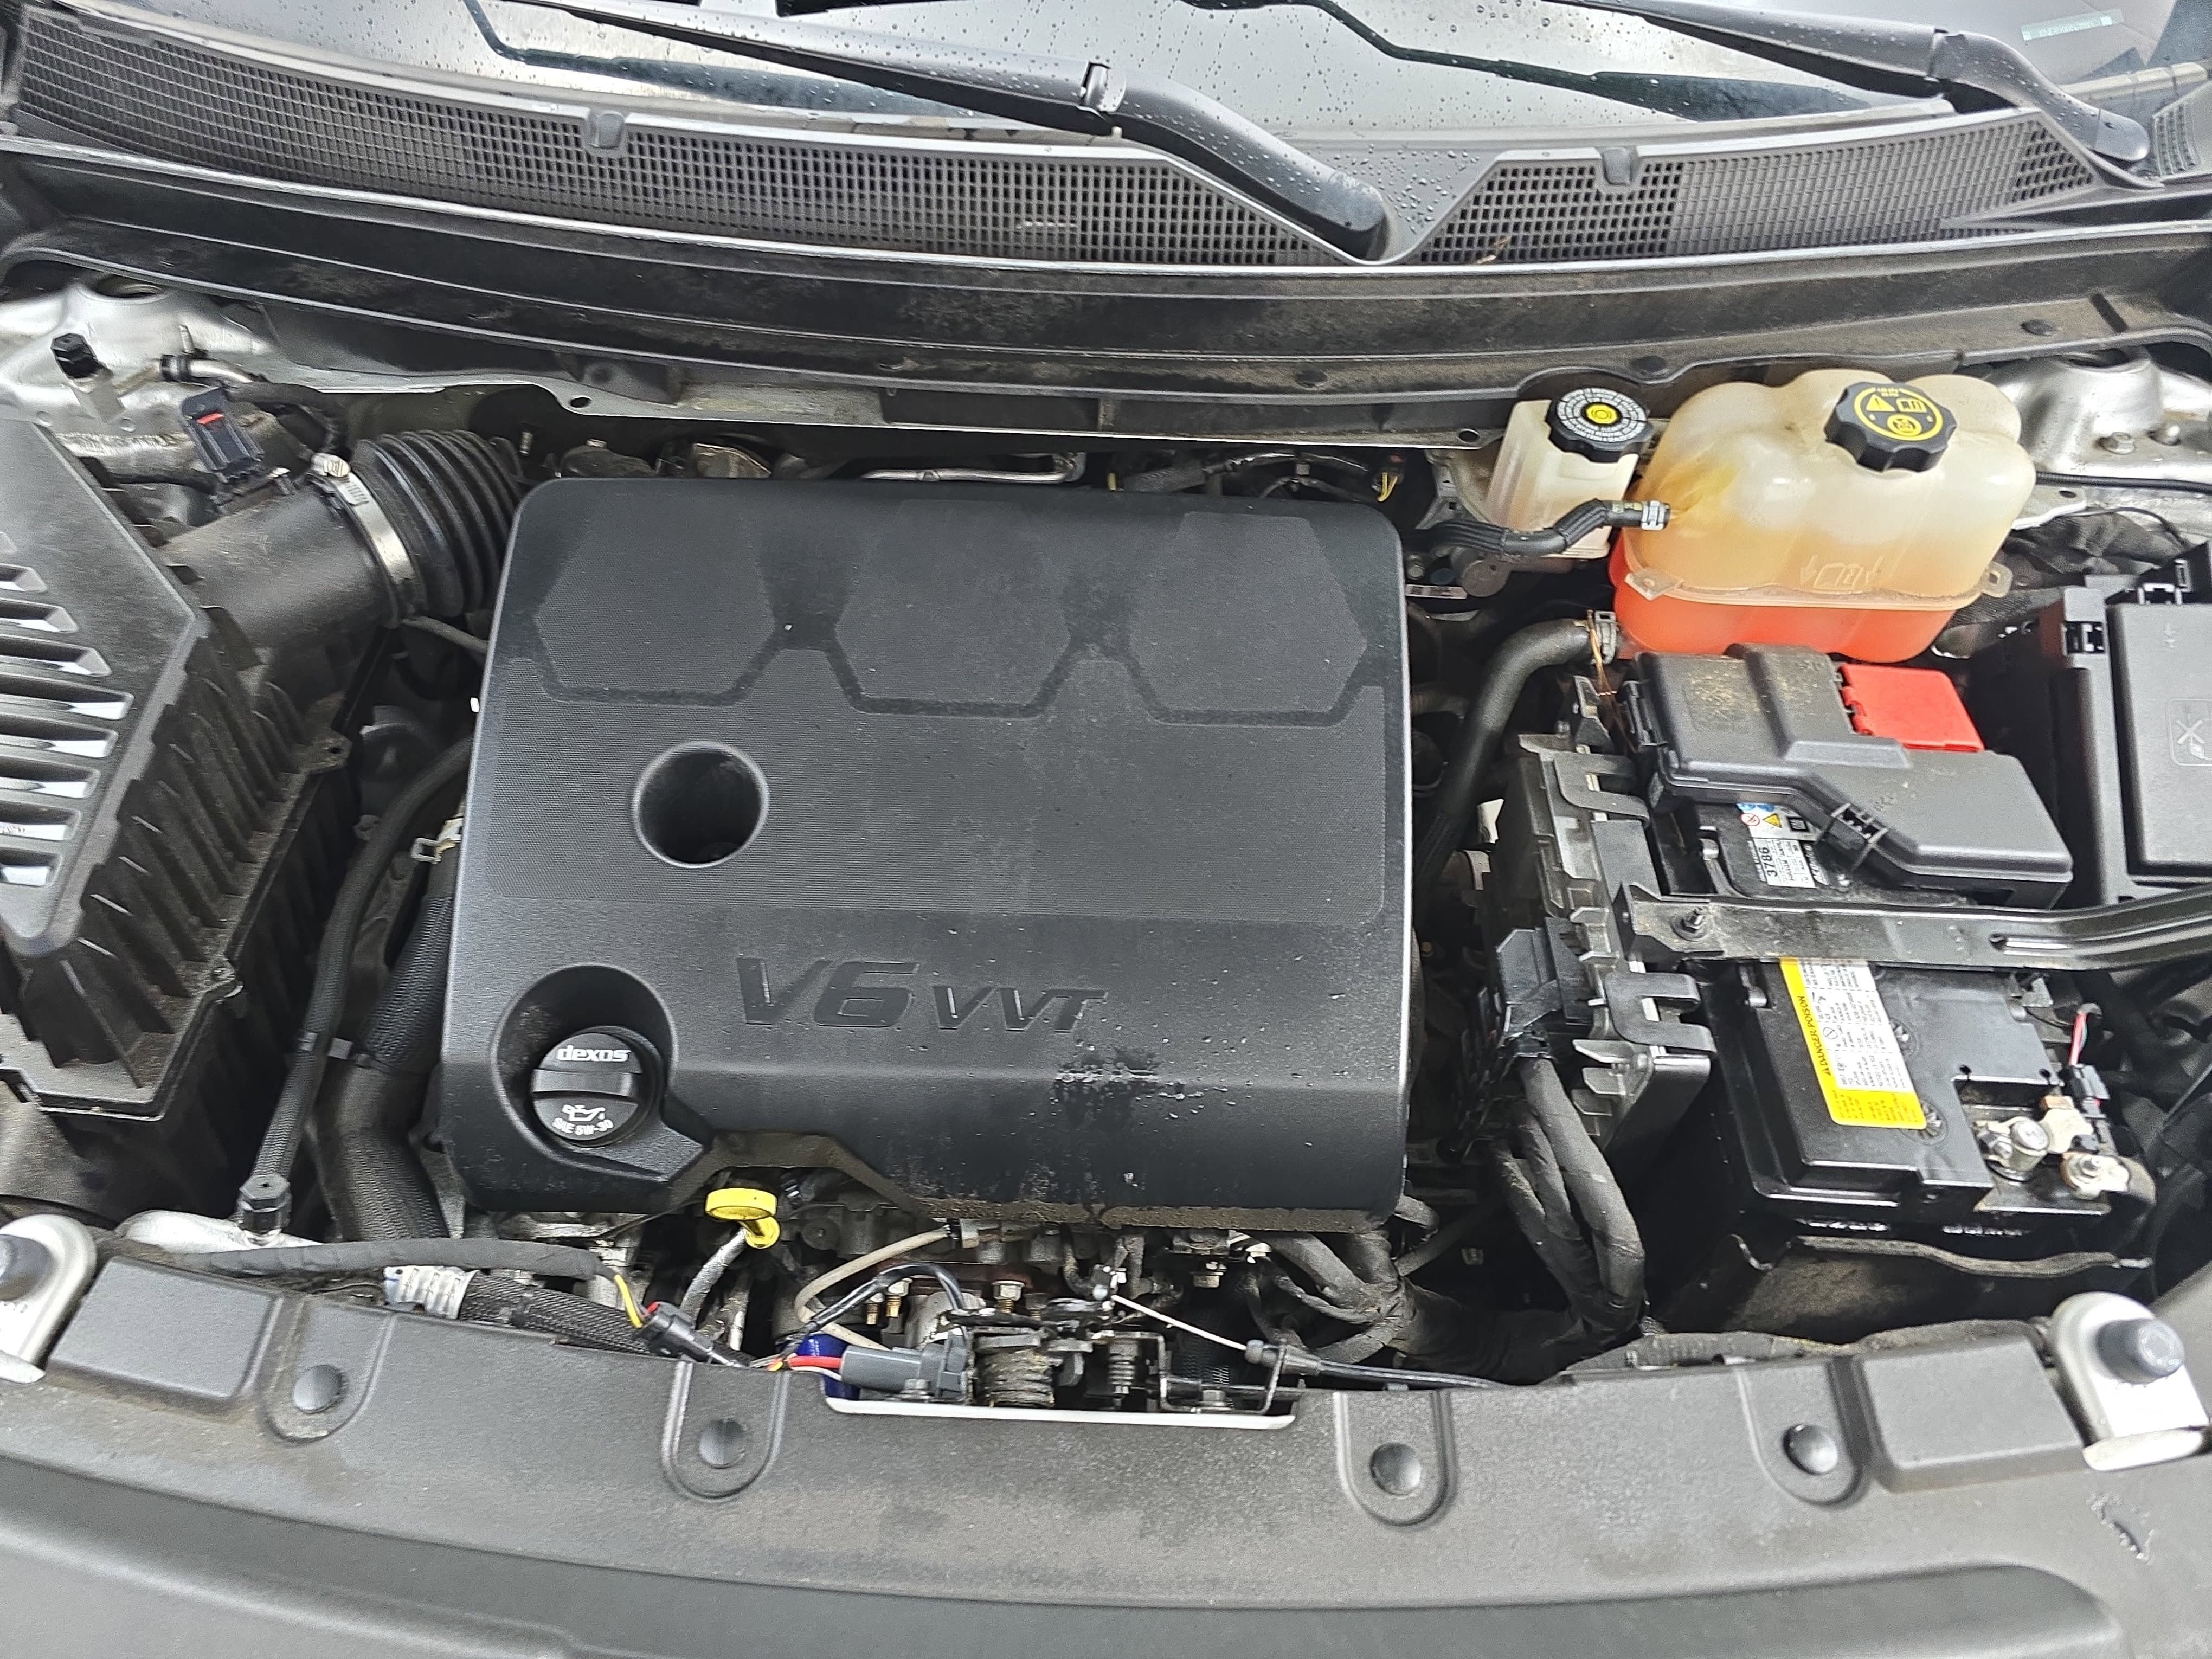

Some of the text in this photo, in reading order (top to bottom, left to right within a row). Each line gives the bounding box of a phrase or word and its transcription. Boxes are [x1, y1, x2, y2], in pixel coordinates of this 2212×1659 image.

[1758, 846, 1778, 877] 3786
[736, 956, 1109, 1033] V6 VVT
[556, 1044, 632, 1062] dexos
[552, 1117, 614, 1135] SAE 5W-30
